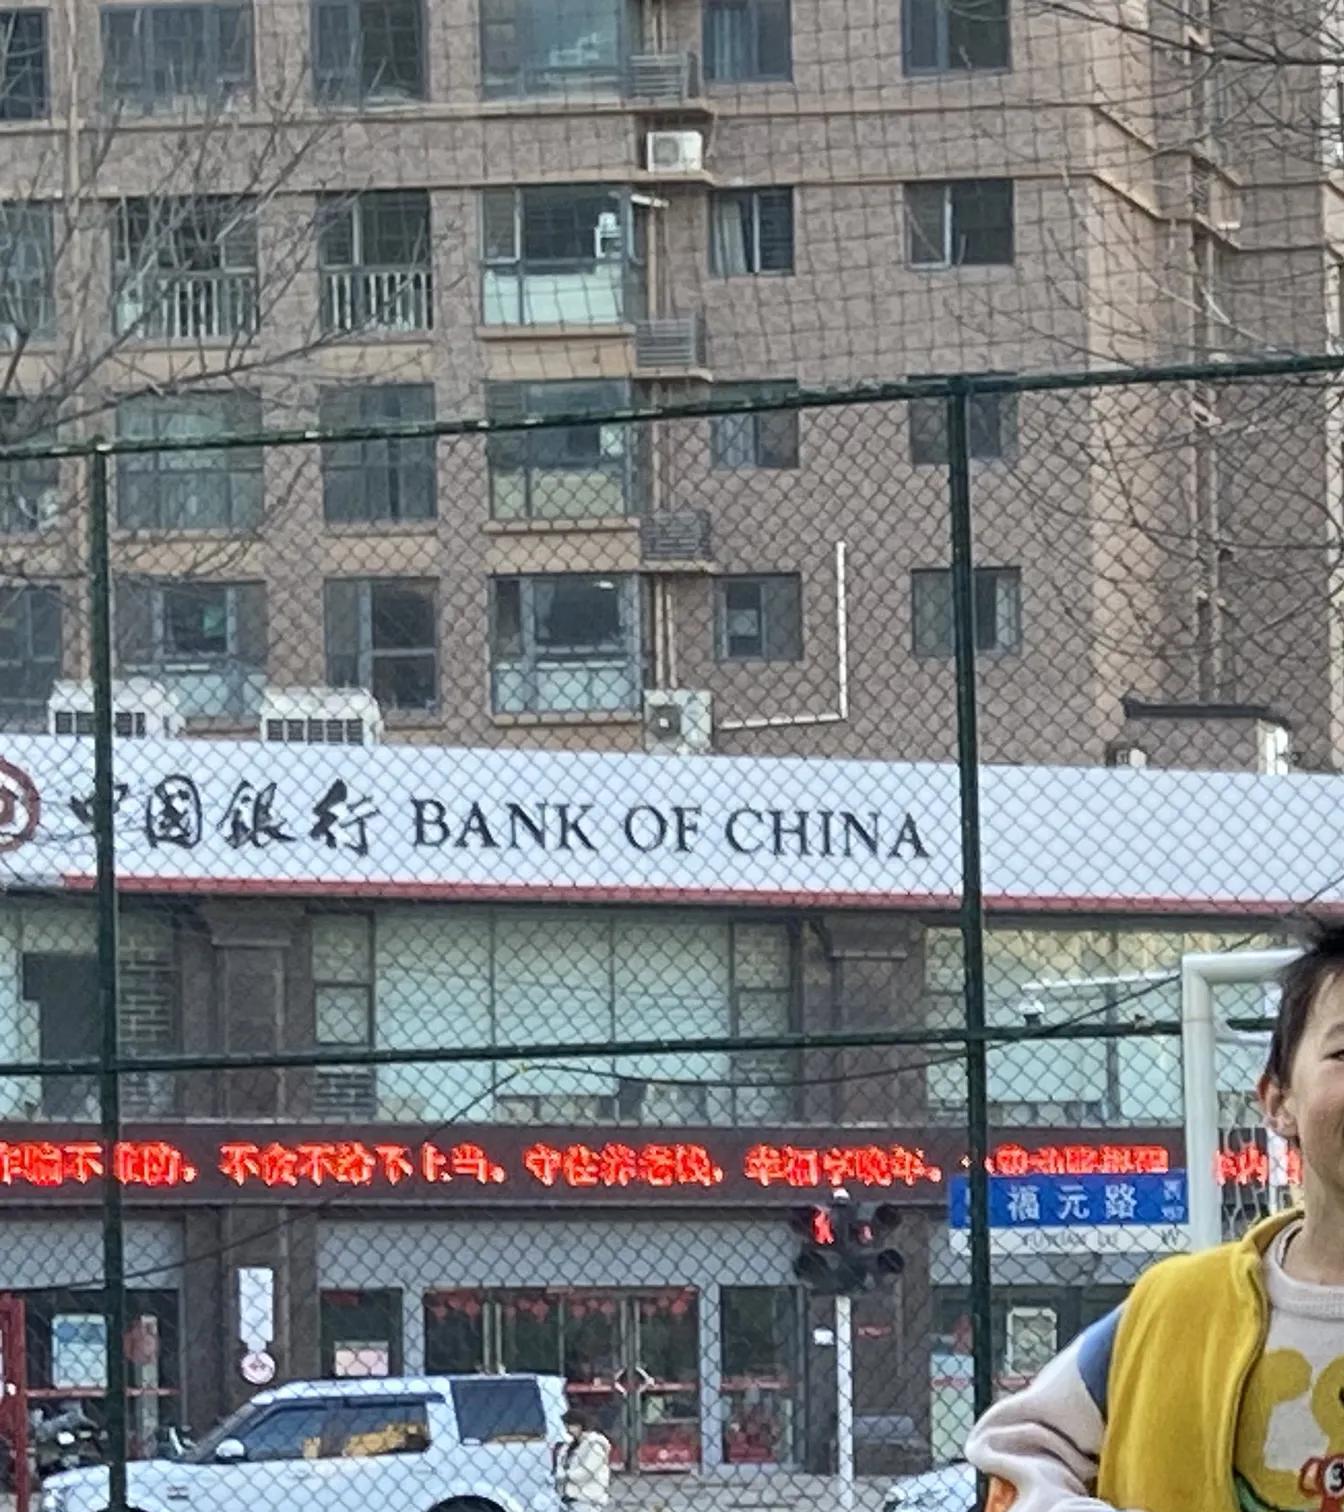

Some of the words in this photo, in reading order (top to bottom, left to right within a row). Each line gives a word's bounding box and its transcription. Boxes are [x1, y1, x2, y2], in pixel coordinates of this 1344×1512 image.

[411, 798, 600, 853] BANK
[623, 804, 700, 853] OF
[724, 808, 931, 861] CHINA
[1007, 1183, 1137, 1221] 福元路
